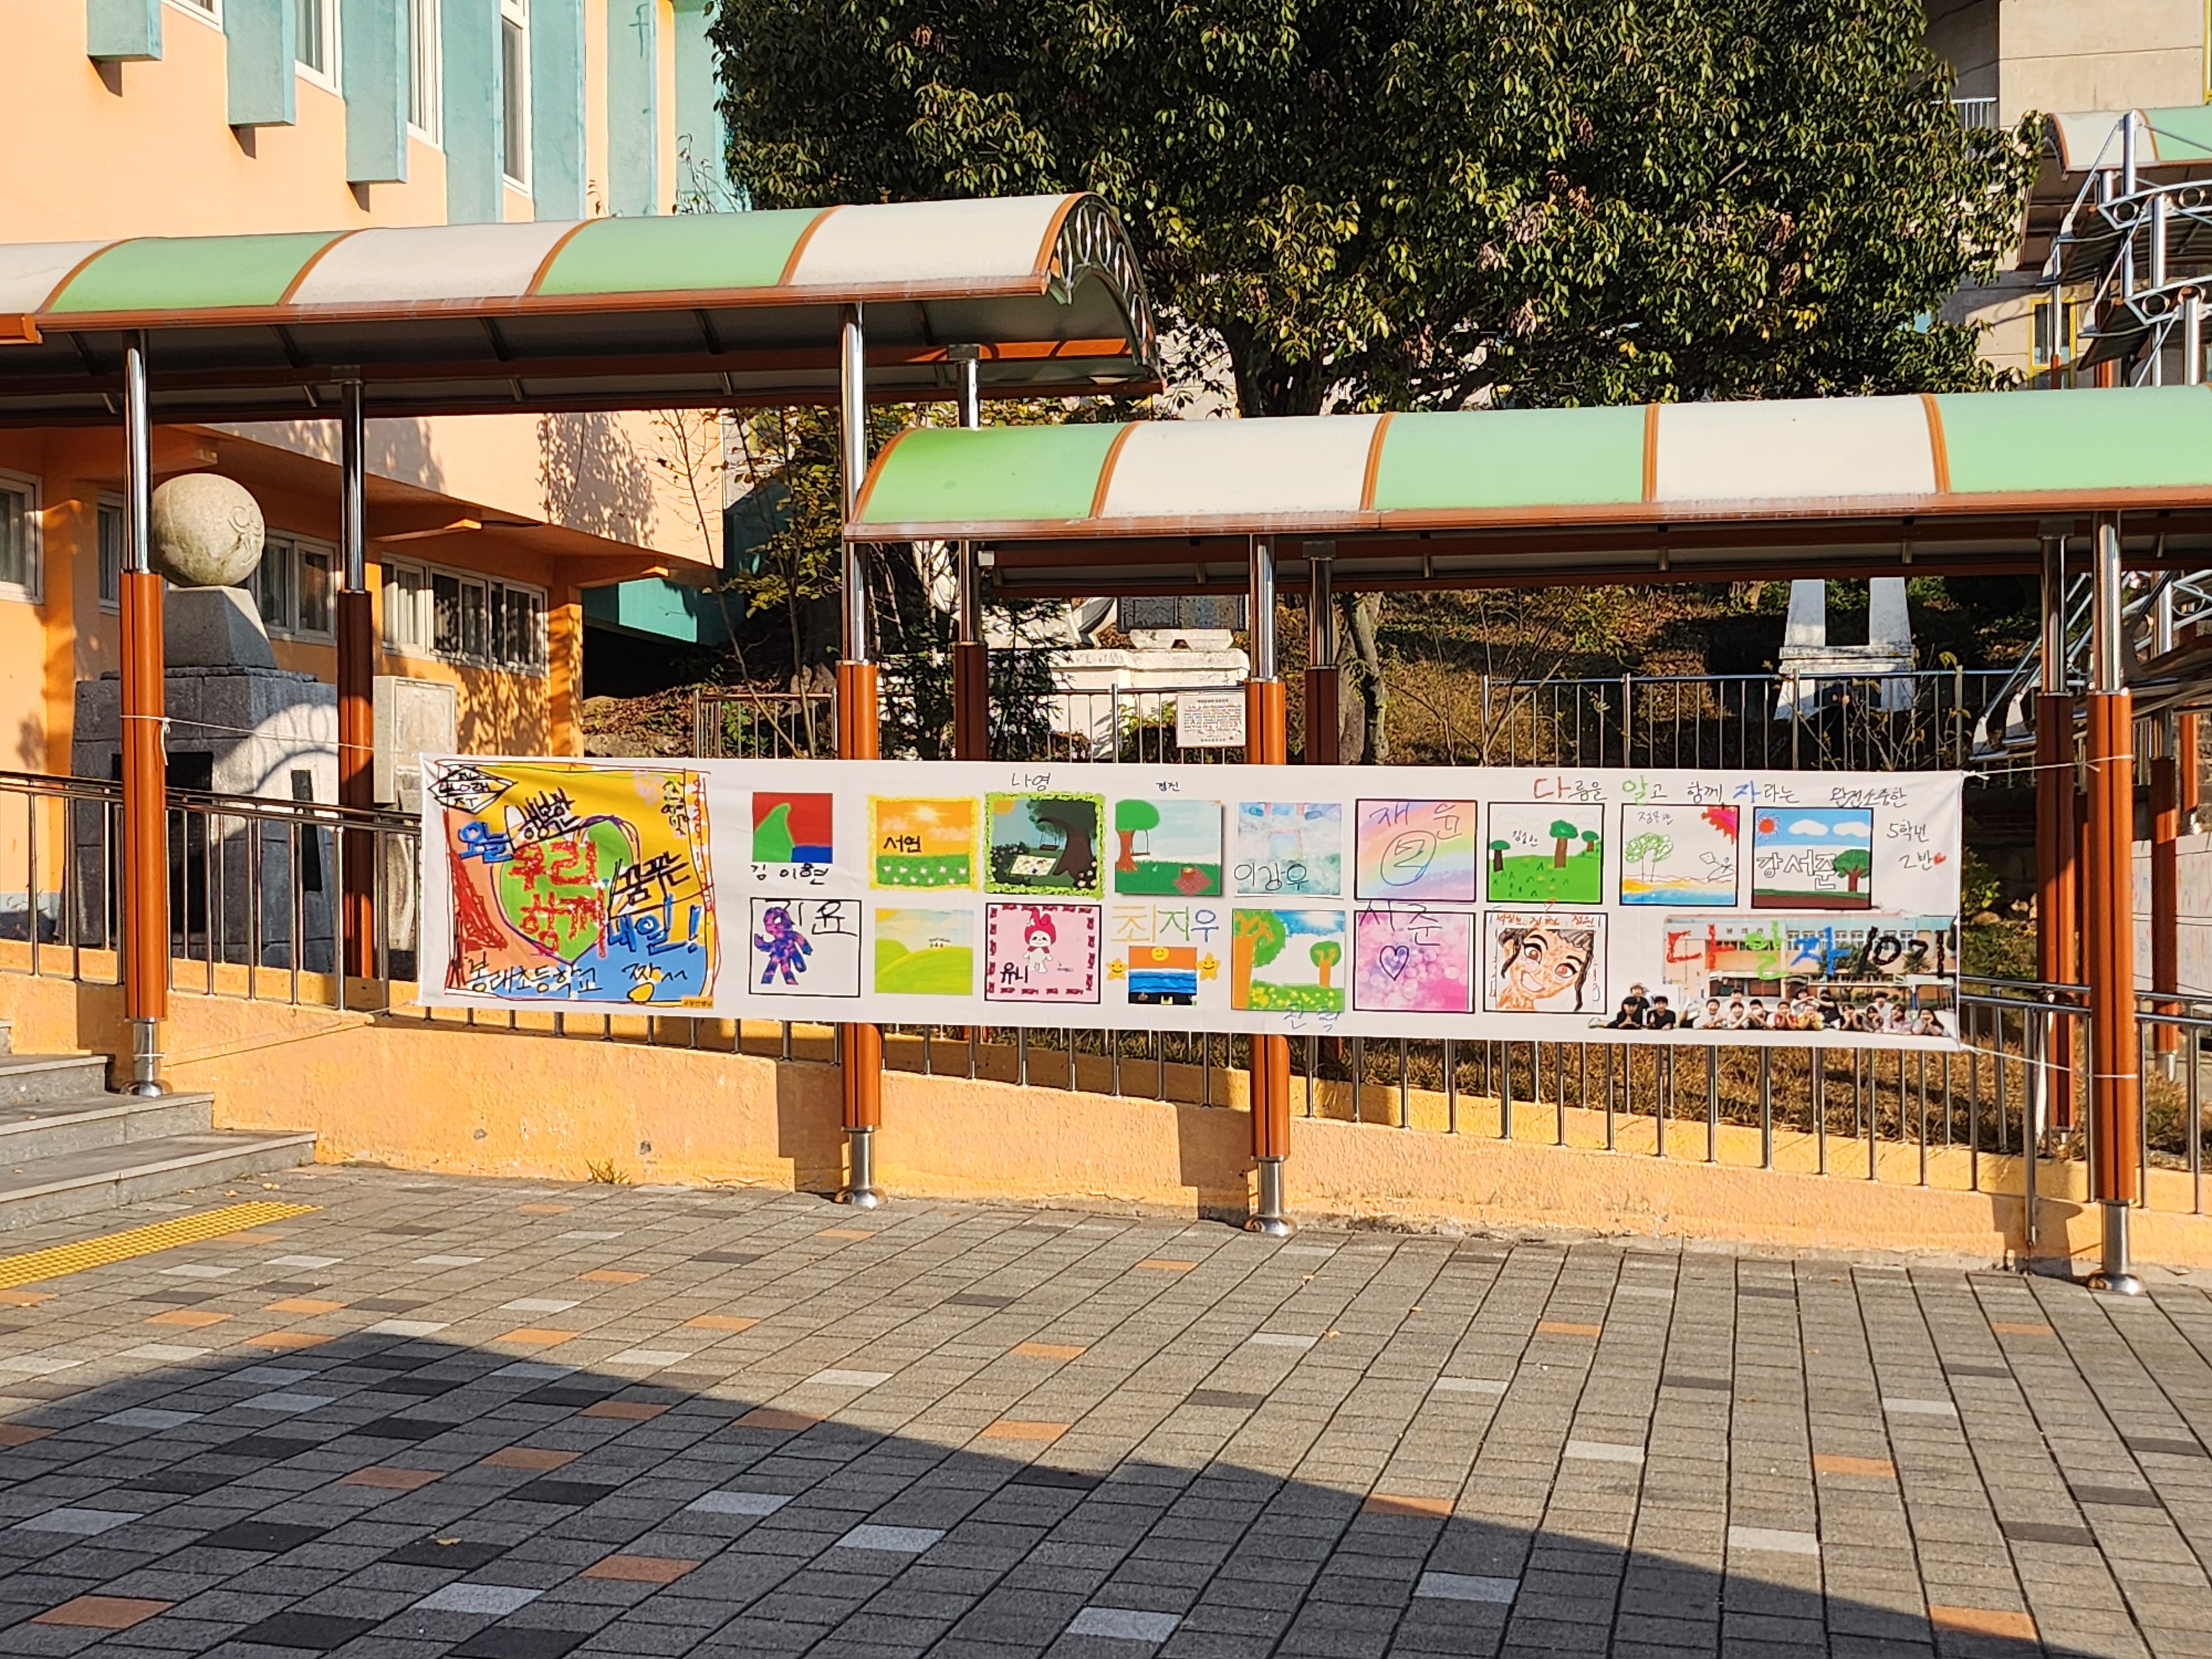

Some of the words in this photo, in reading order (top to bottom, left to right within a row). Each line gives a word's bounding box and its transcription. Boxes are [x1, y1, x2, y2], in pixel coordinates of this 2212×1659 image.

[1011, 772, 1051, 791] 나영
[1533, 776, 1607, 802] 다름을
[1622, 775, 1668, 806] 알고
[1687, 781, 1723, 803] 함께
[1732, 780, 1800, 804] 자라는
[508, 841, 598, 891] 우리
[1756, 849, 1837, 890] 강서준
[1111, 904, 1219, 943] 최지우
